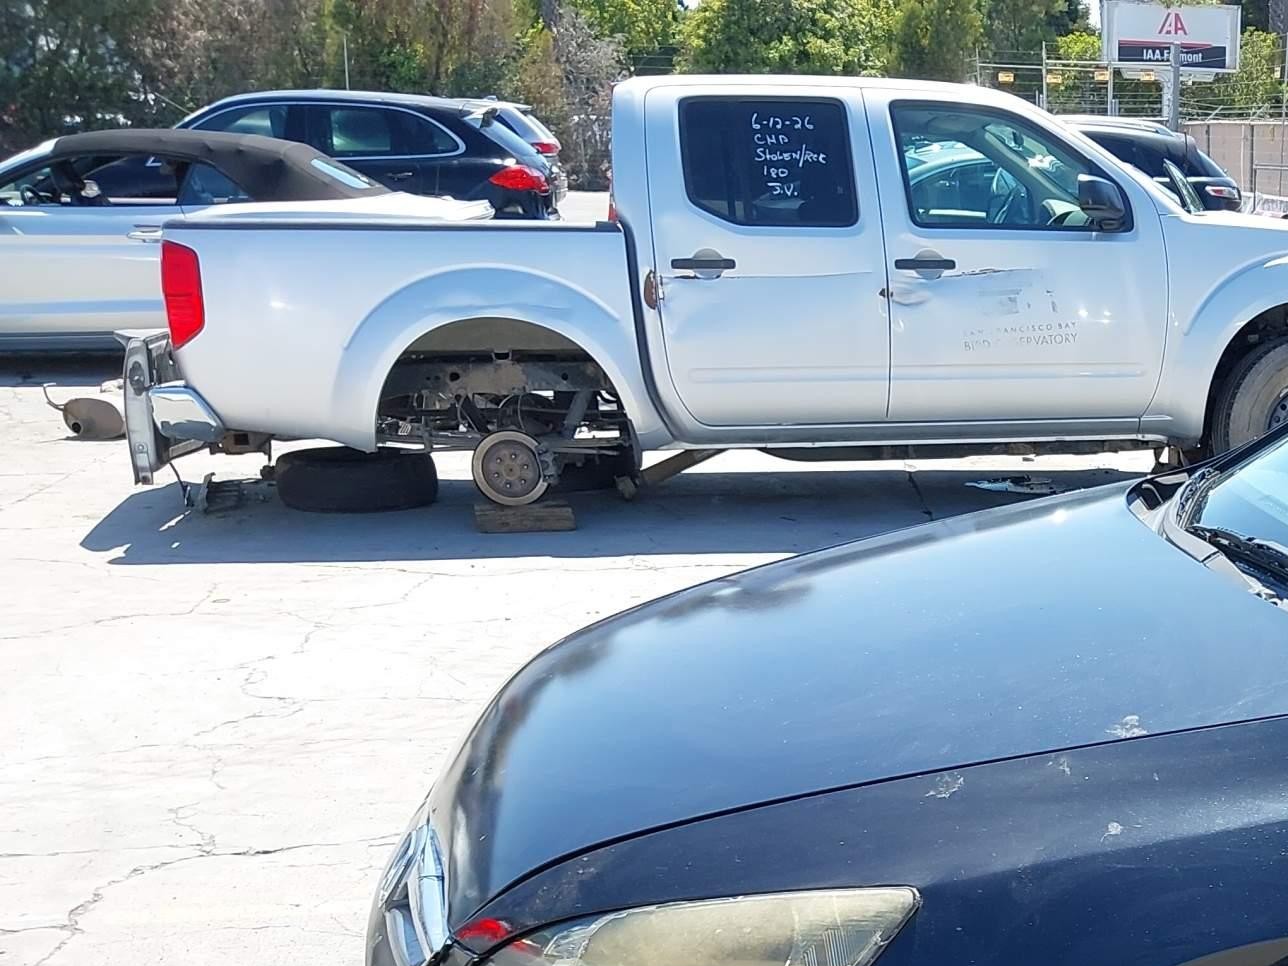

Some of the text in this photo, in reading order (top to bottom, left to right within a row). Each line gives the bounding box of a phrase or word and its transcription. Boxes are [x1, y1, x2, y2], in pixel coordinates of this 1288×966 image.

[1143, 48, 1203, 63] IAA Fmont
[751, 113, 814, 130] 6-12-26
[763, 165, 789, 178] 180
